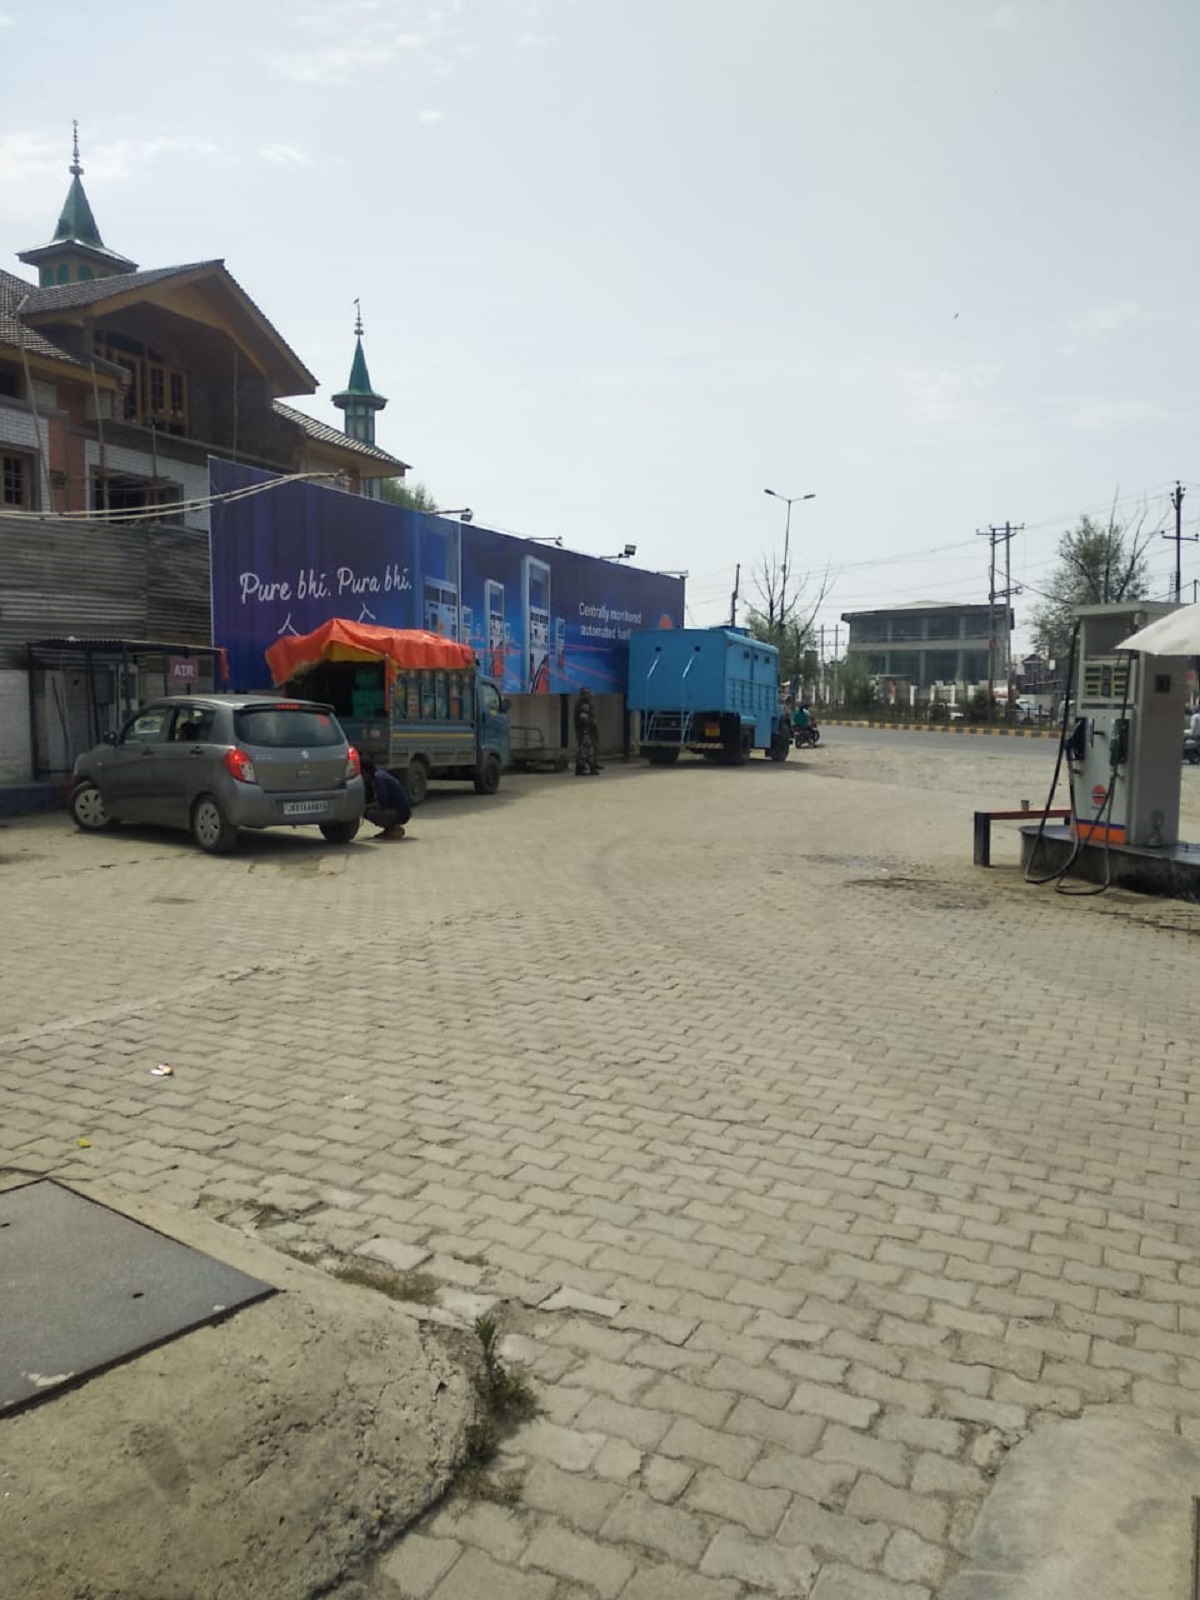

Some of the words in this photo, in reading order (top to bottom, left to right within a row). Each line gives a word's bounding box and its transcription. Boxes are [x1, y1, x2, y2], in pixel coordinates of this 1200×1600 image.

[239, 572, 292, 605] Pure
[297, 568, 332, 600] bhi.
[336, 566, 381, 596] Pura
[384, 563, 413, 592] bhi.
[174, 664, 195, 677] AIR
